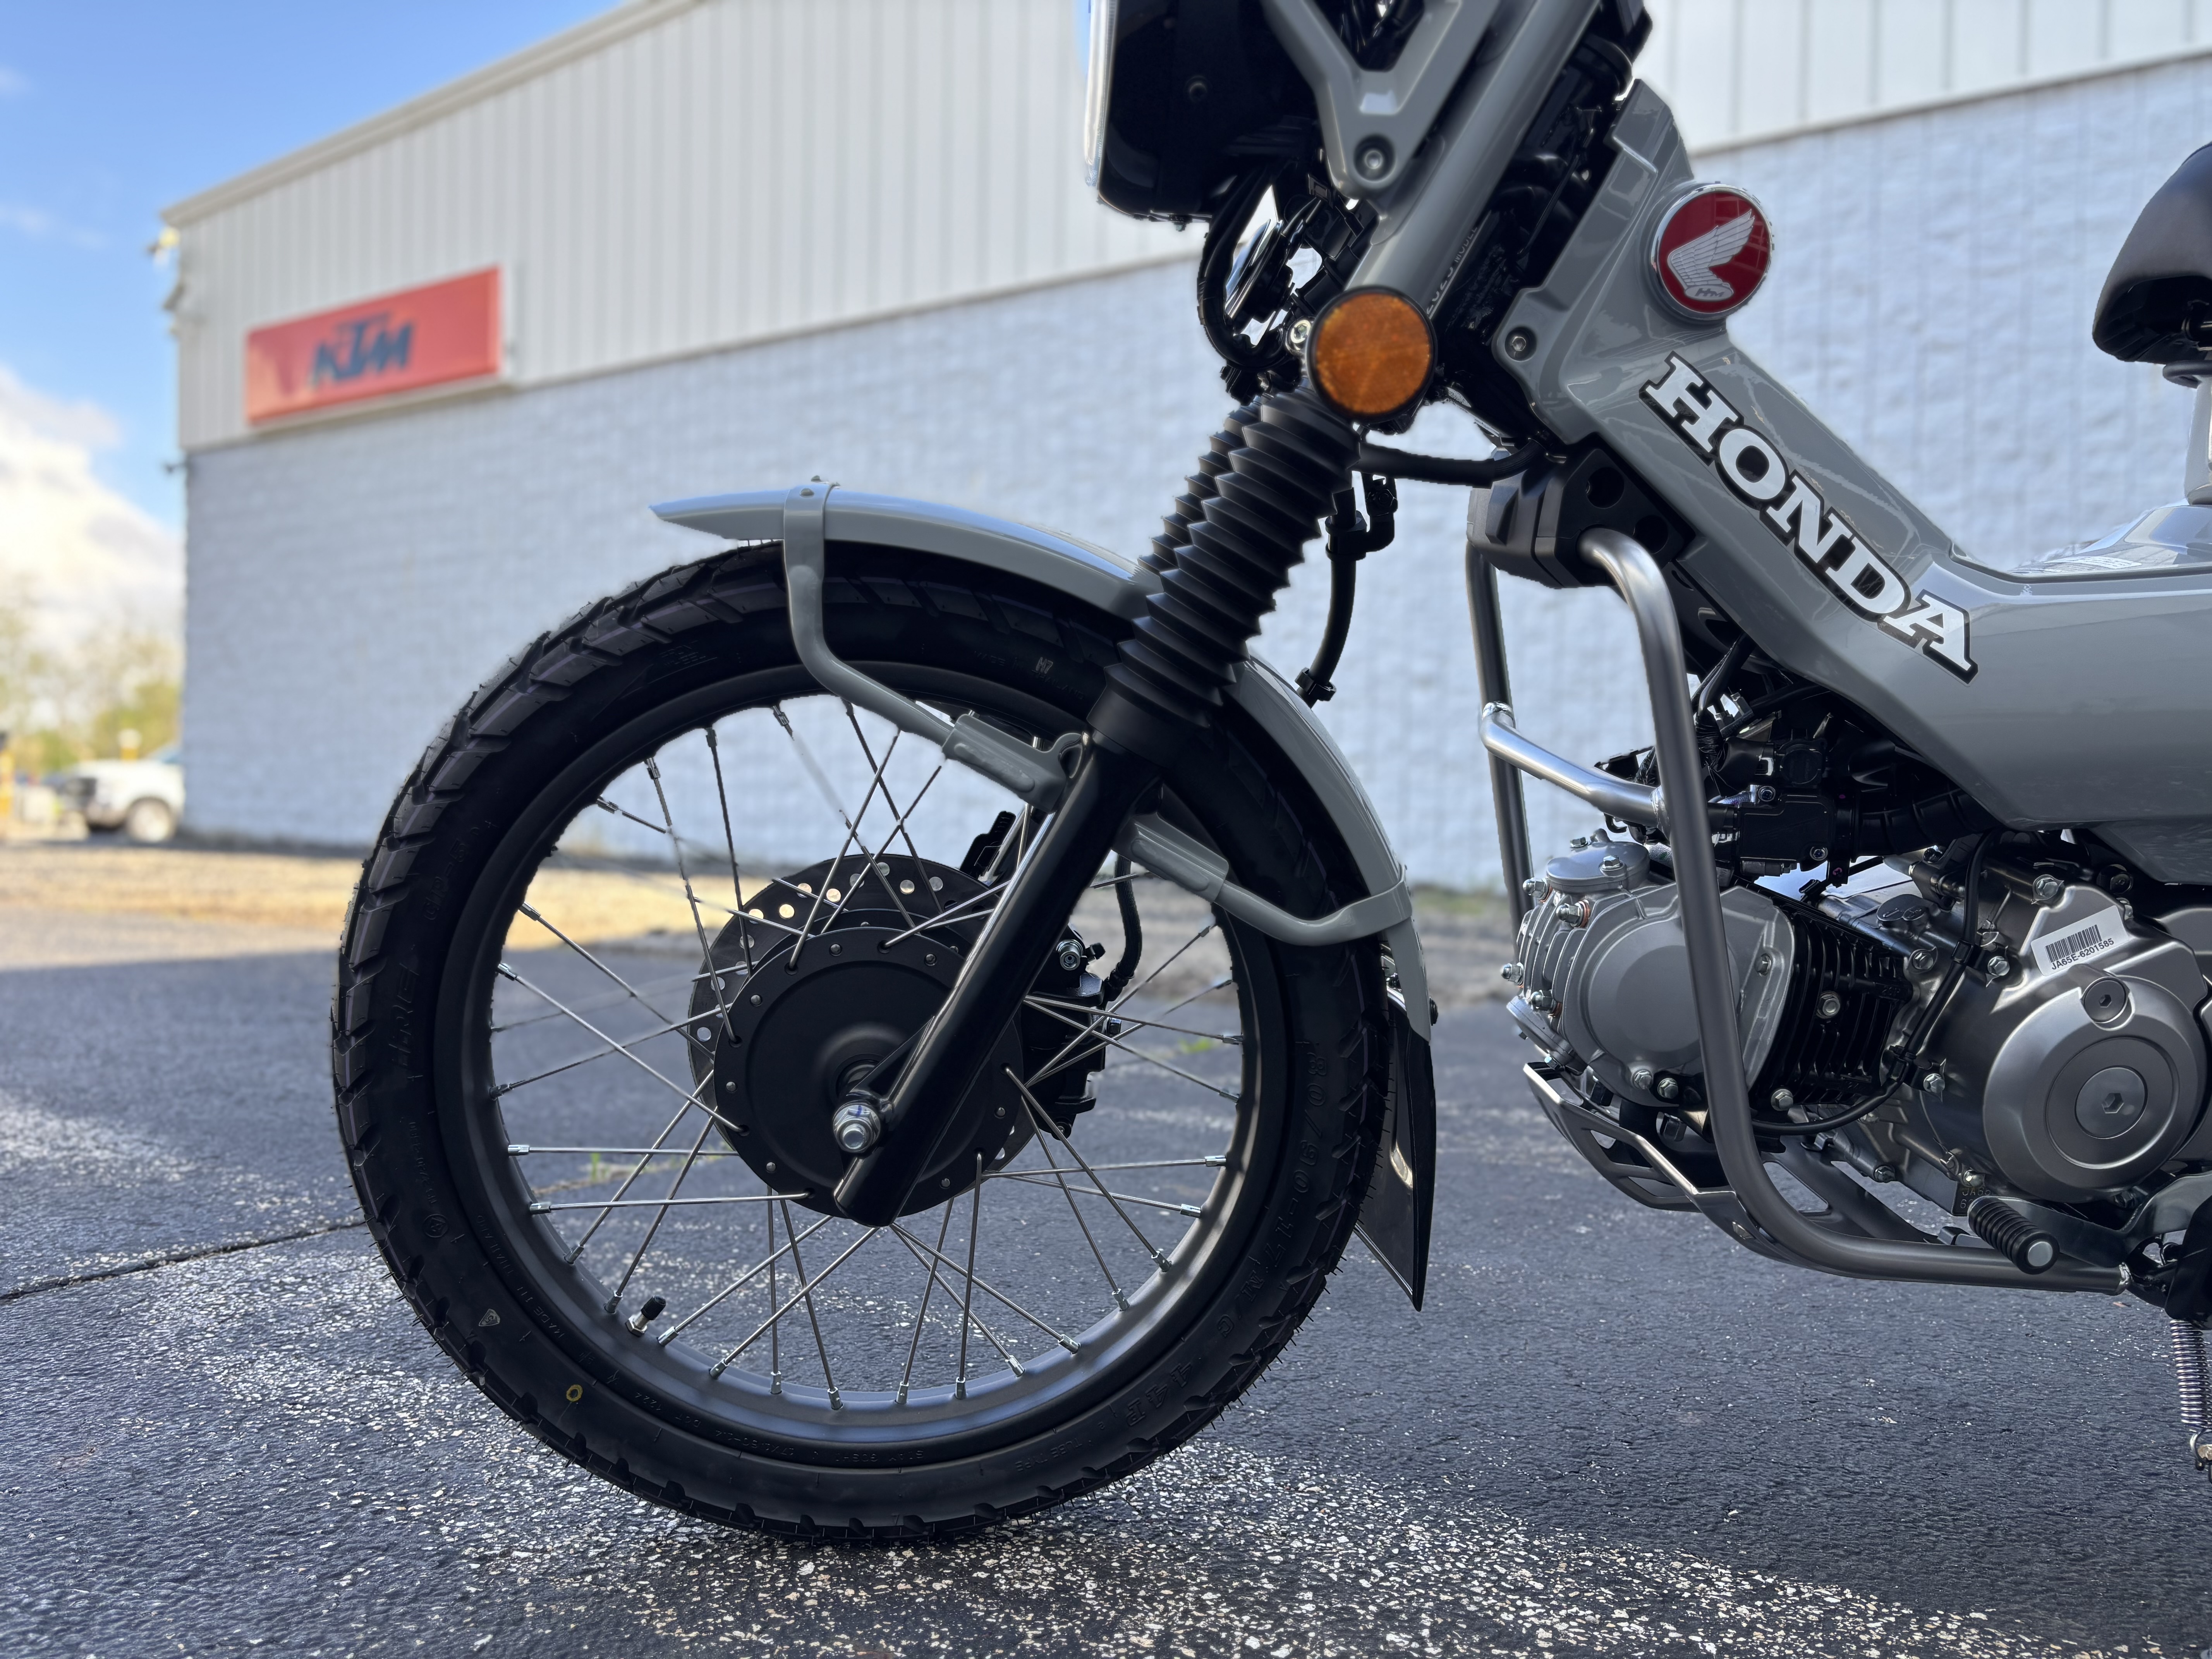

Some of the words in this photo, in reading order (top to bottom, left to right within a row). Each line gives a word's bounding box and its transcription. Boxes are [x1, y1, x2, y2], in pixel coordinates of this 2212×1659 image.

[309, 311, 414, 387] KTM
[1643, 353, 1974, 675] HONDA
[422, 838, 471, 921] GP-5
[2052, 938, 2114, 970] JA65E-6201585
[1264, 1051, 1328, 1268] 80/90-17
[1962, 1187, 1996, 1196] JA65
[475, 1214, 515, 1276] THAILAND
[483, 1313, 495, 1324] 5
[533, 1306, 566, 1339] MADE
[1217, 1270, 1266, 1339] M/C
[1124, 1362, 1194, 1427] 44P
[1014, 1454, 1049, 1472] TYPE
[1049, 1436, 1084, 1459] TUBE
